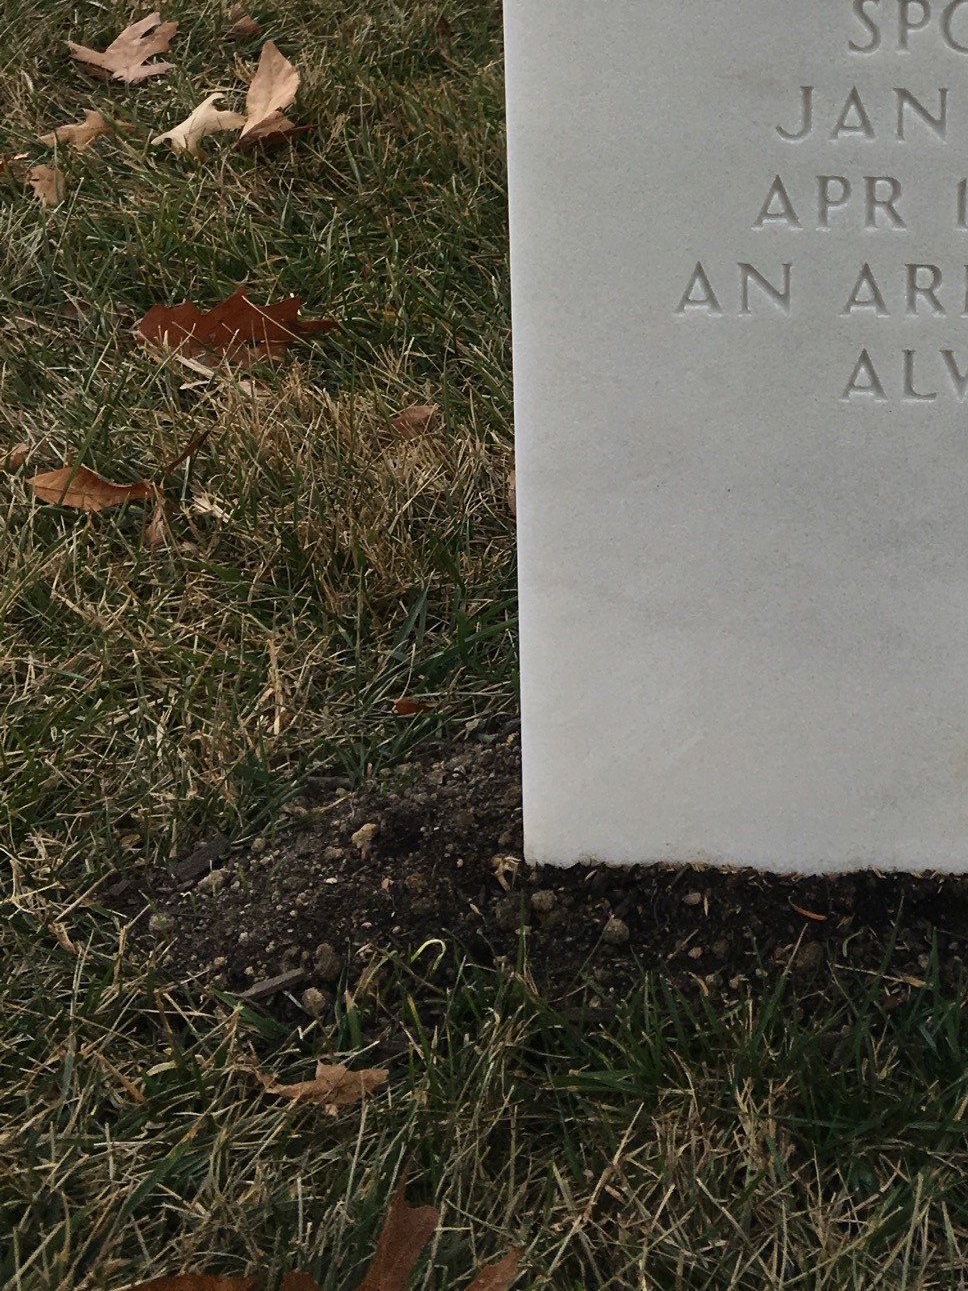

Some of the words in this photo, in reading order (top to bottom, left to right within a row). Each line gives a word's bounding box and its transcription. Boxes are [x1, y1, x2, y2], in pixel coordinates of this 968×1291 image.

[774, 85, 949, 144] JAN
[751, 174, 907, 231] APR
[673, 261, 793, 316] AN
